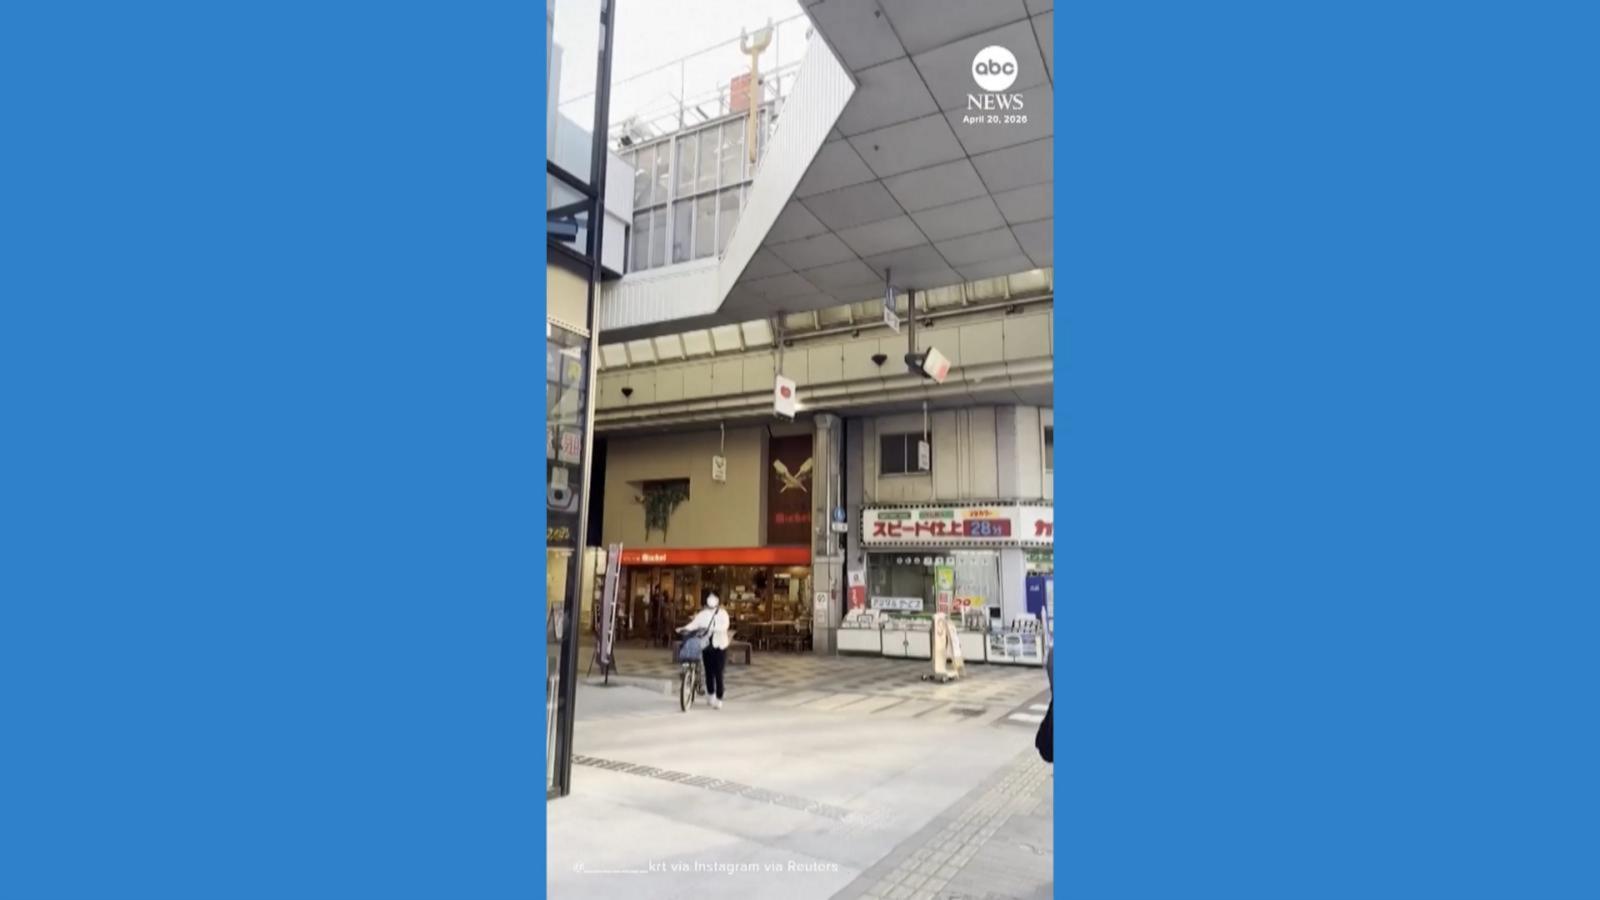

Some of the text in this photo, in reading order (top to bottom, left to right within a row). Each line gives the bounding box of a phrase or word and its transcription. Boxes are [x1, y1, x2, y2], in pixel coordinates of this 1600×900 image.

[872, 520, 963, 538] スピード仕上
